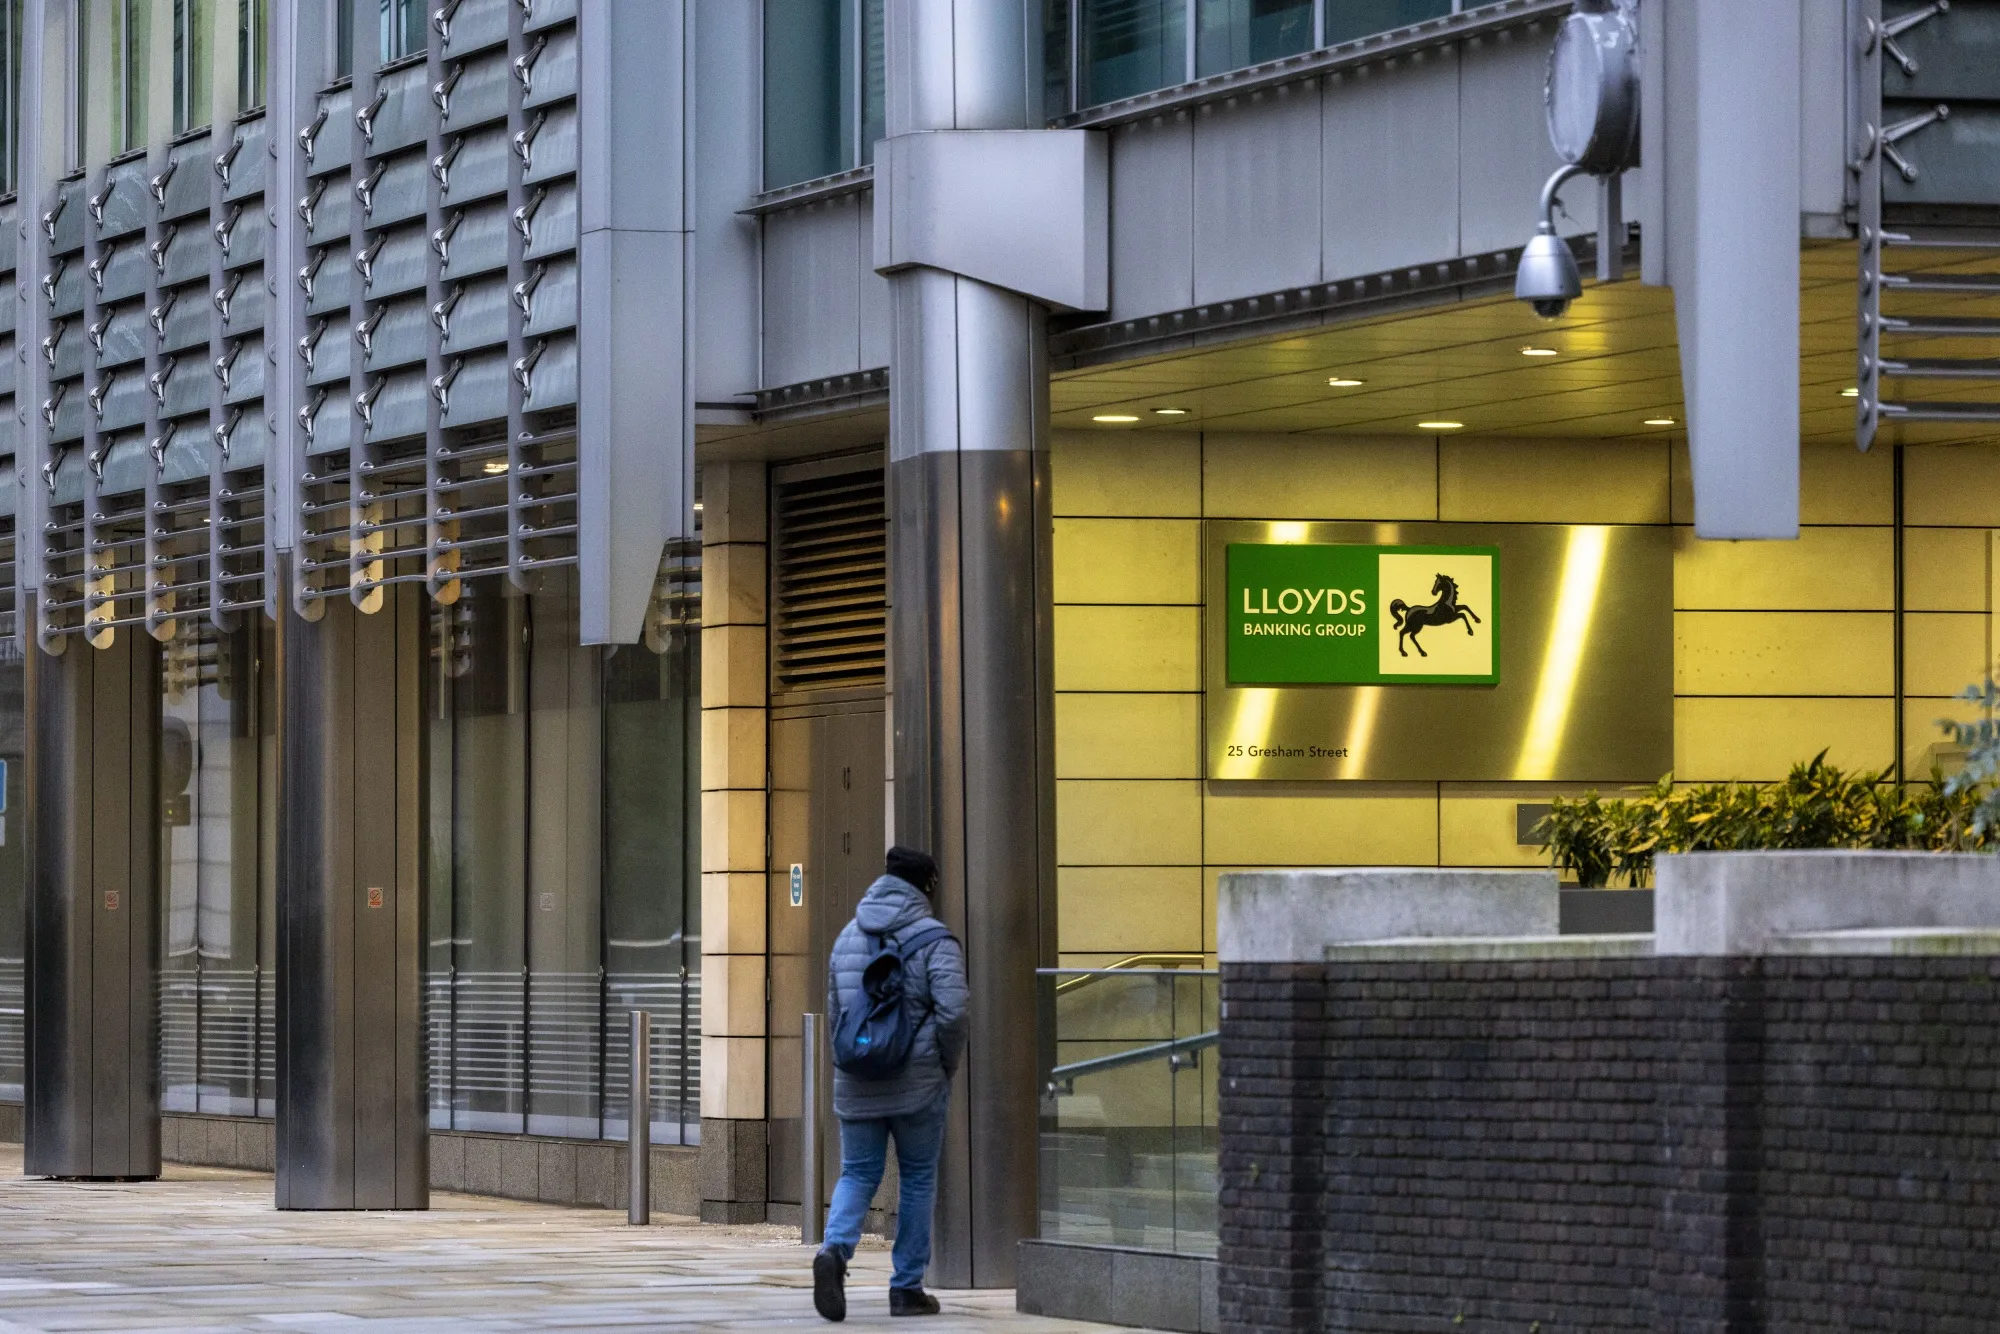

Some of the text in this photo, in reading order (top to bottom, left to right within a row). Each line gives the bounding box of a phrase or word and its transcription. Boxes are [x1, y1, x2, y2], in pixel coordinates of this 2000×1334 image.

[1243, 587, 1367, 616] LLOYDS
[1243, 622, 1367, 637] BANKING GROUP
[1227, 745, 1349, 758] 25 Gresham Street
